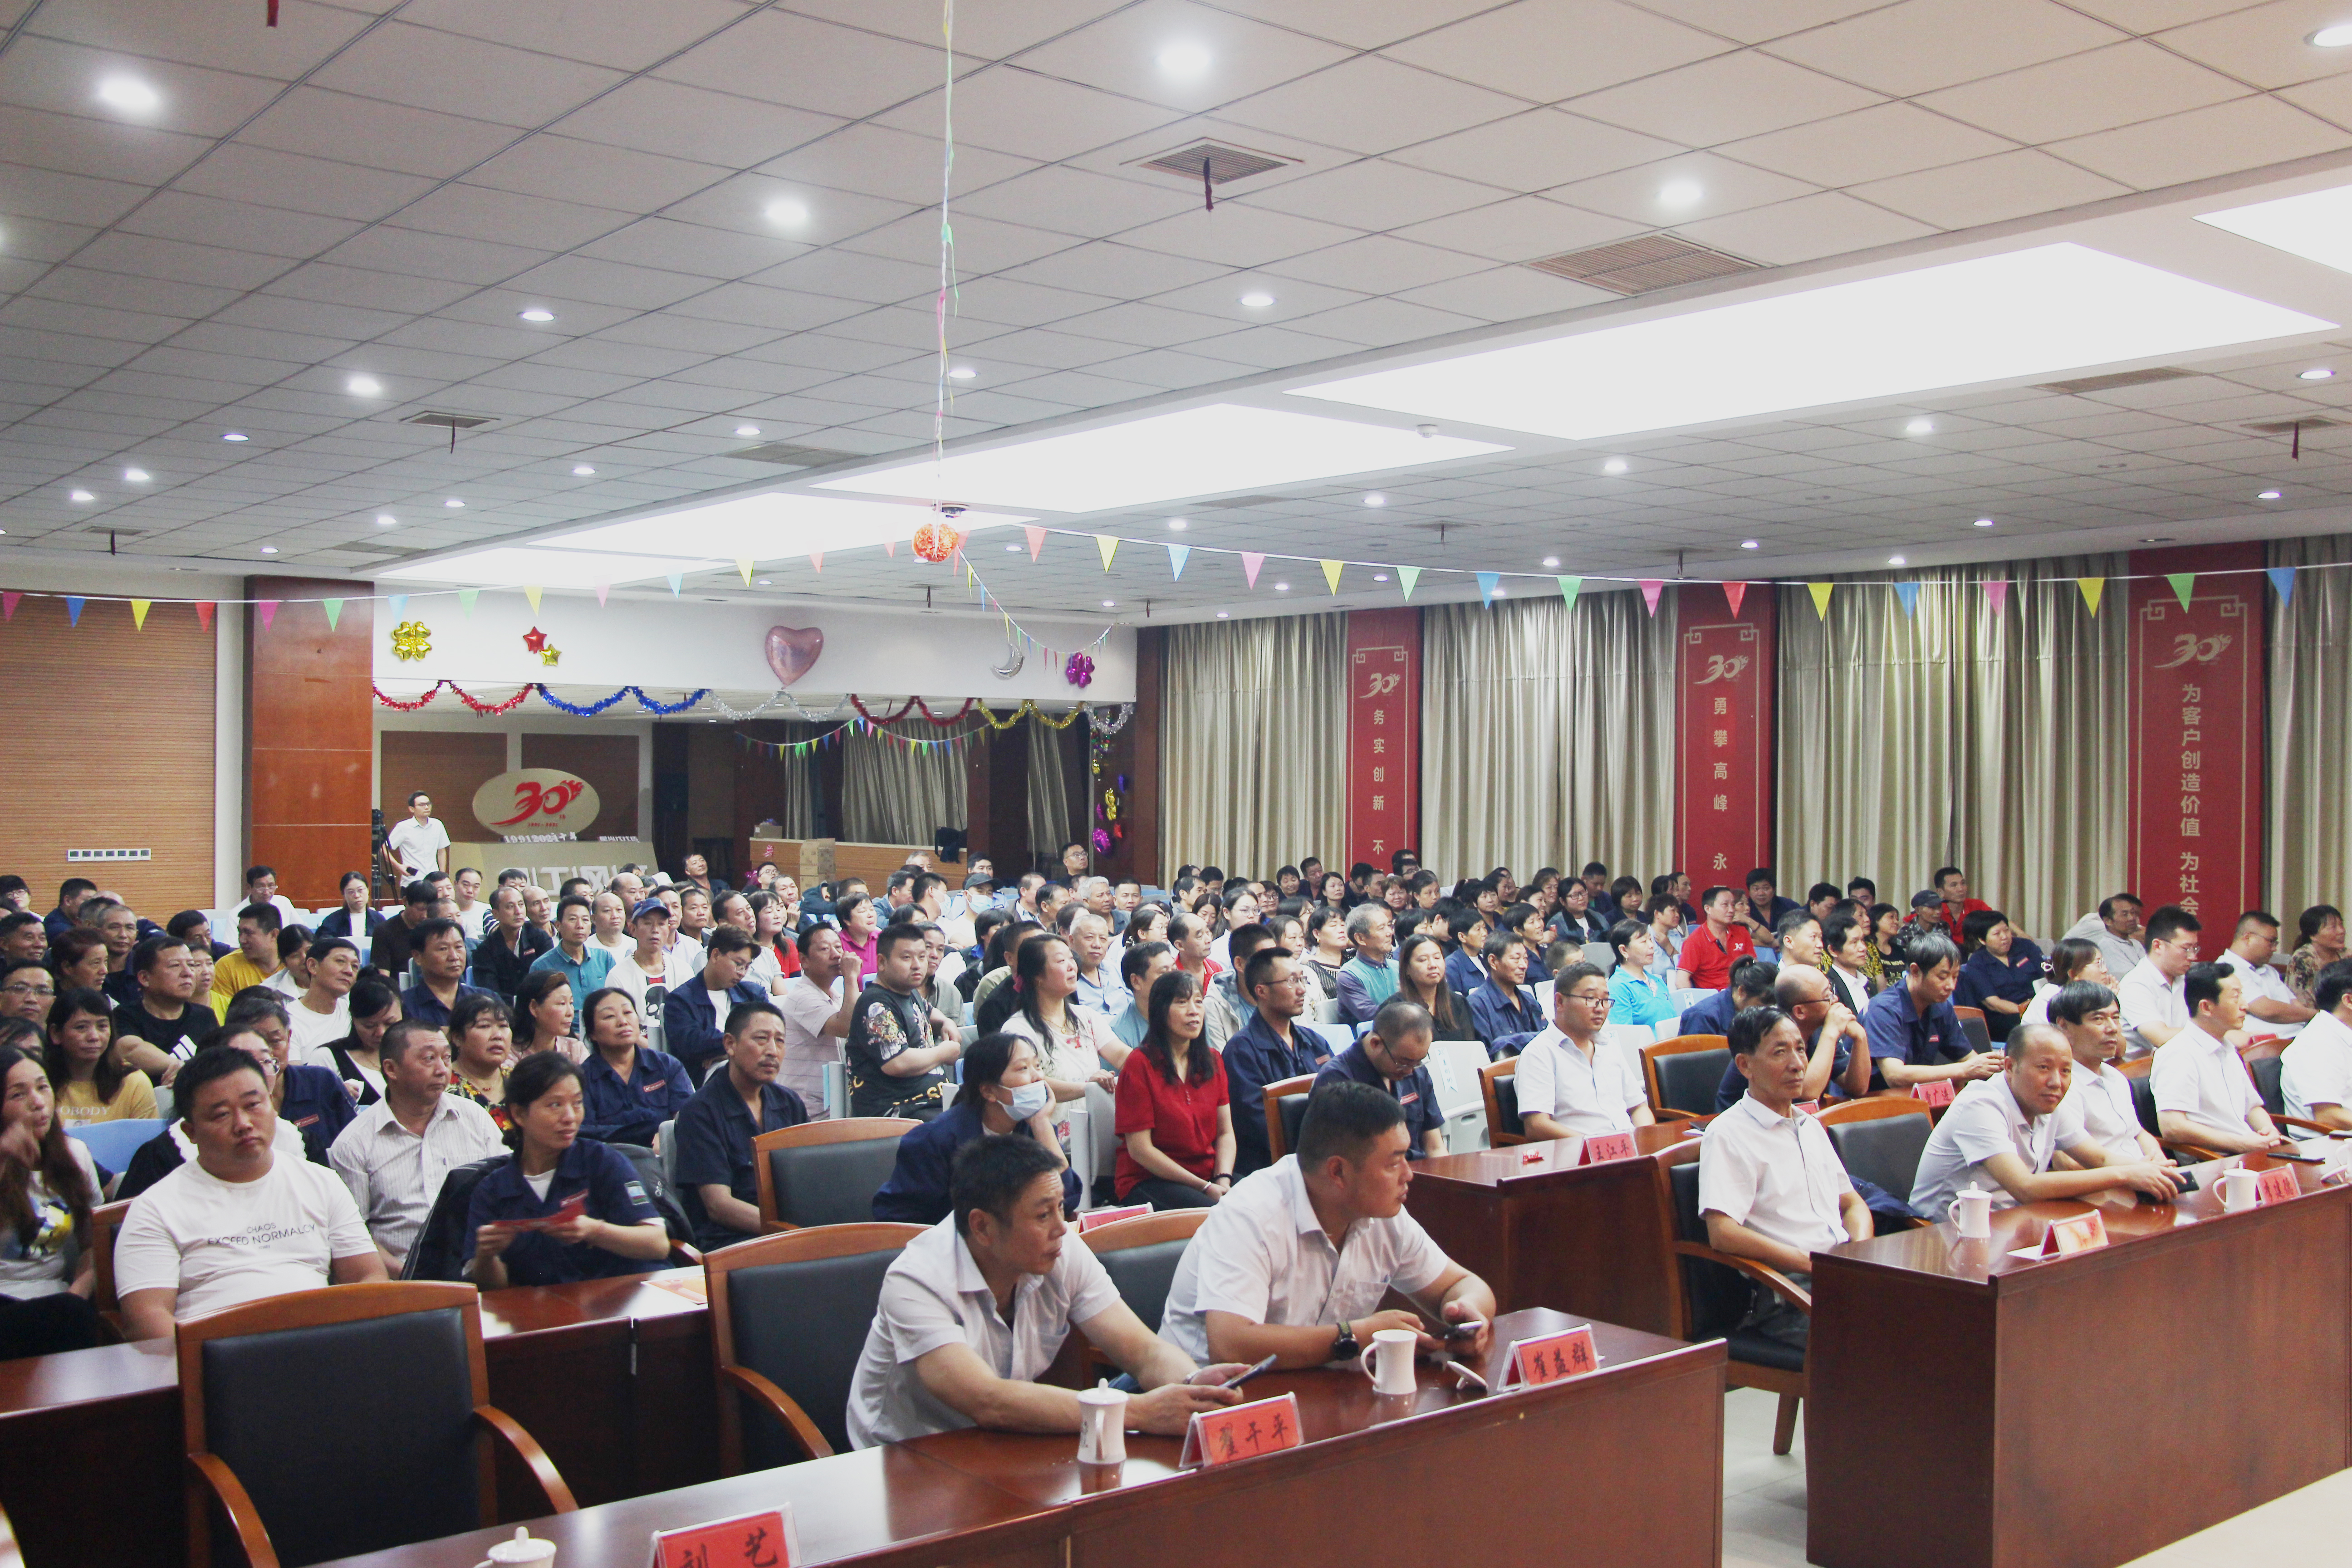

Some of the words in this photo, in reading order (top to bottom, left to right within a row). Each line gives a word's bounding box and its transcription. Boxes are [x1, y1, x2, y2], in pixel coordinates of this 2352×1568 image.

[2154, 633, 2226, 668] 30
[1359, 673, 1397, 698] 30
[1693, 655, 1744, 684] 30
[1373, 709, 1384, 811] 务实创新
[1713, 697, 1728, 812] 勇攀高峰
[2180, 684, 2201, 837] 为客户创造价值
[490, 781, 576, 827] 30
[207, 1236, 249, 1245] EXCEED
[252, 1223, 315, 1244] NORMALCY
[247, 1222, 276, 1234] CHAOS
